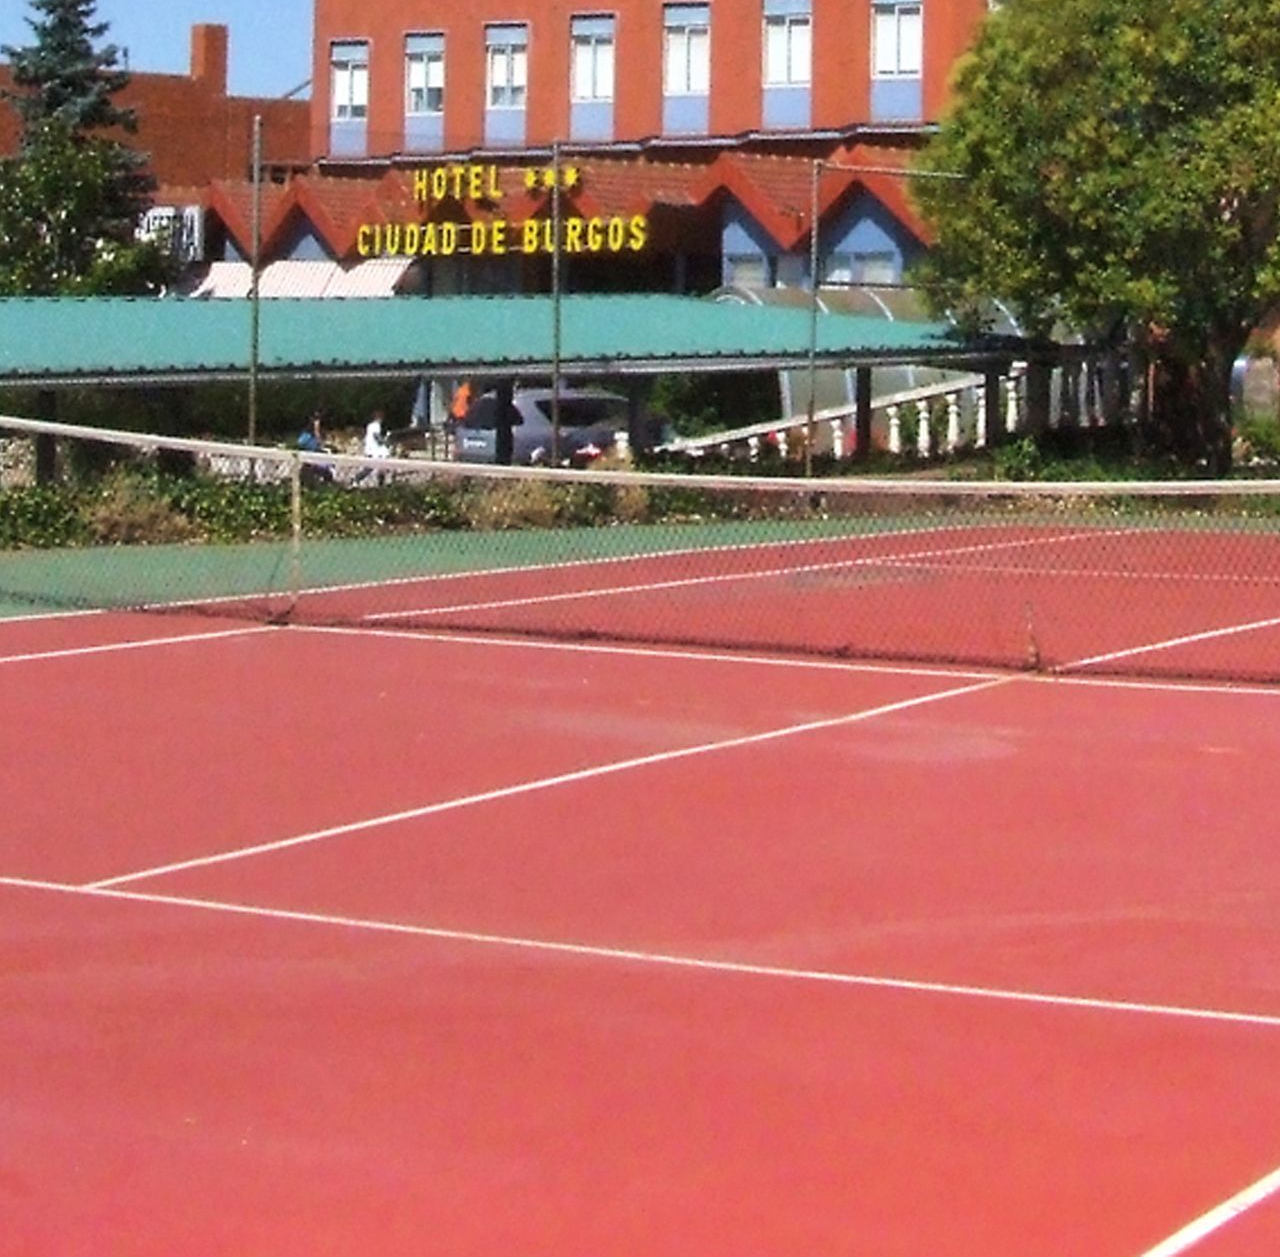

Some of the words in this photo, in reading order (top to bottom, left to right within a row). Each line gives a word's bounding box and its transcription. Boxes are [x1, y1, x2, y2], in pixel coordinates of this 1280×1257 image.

[412, 165, 504, 200] HOTEL
[355, 222, 458, 257] CIUDAD
[470, 217, 507, 255] DE
